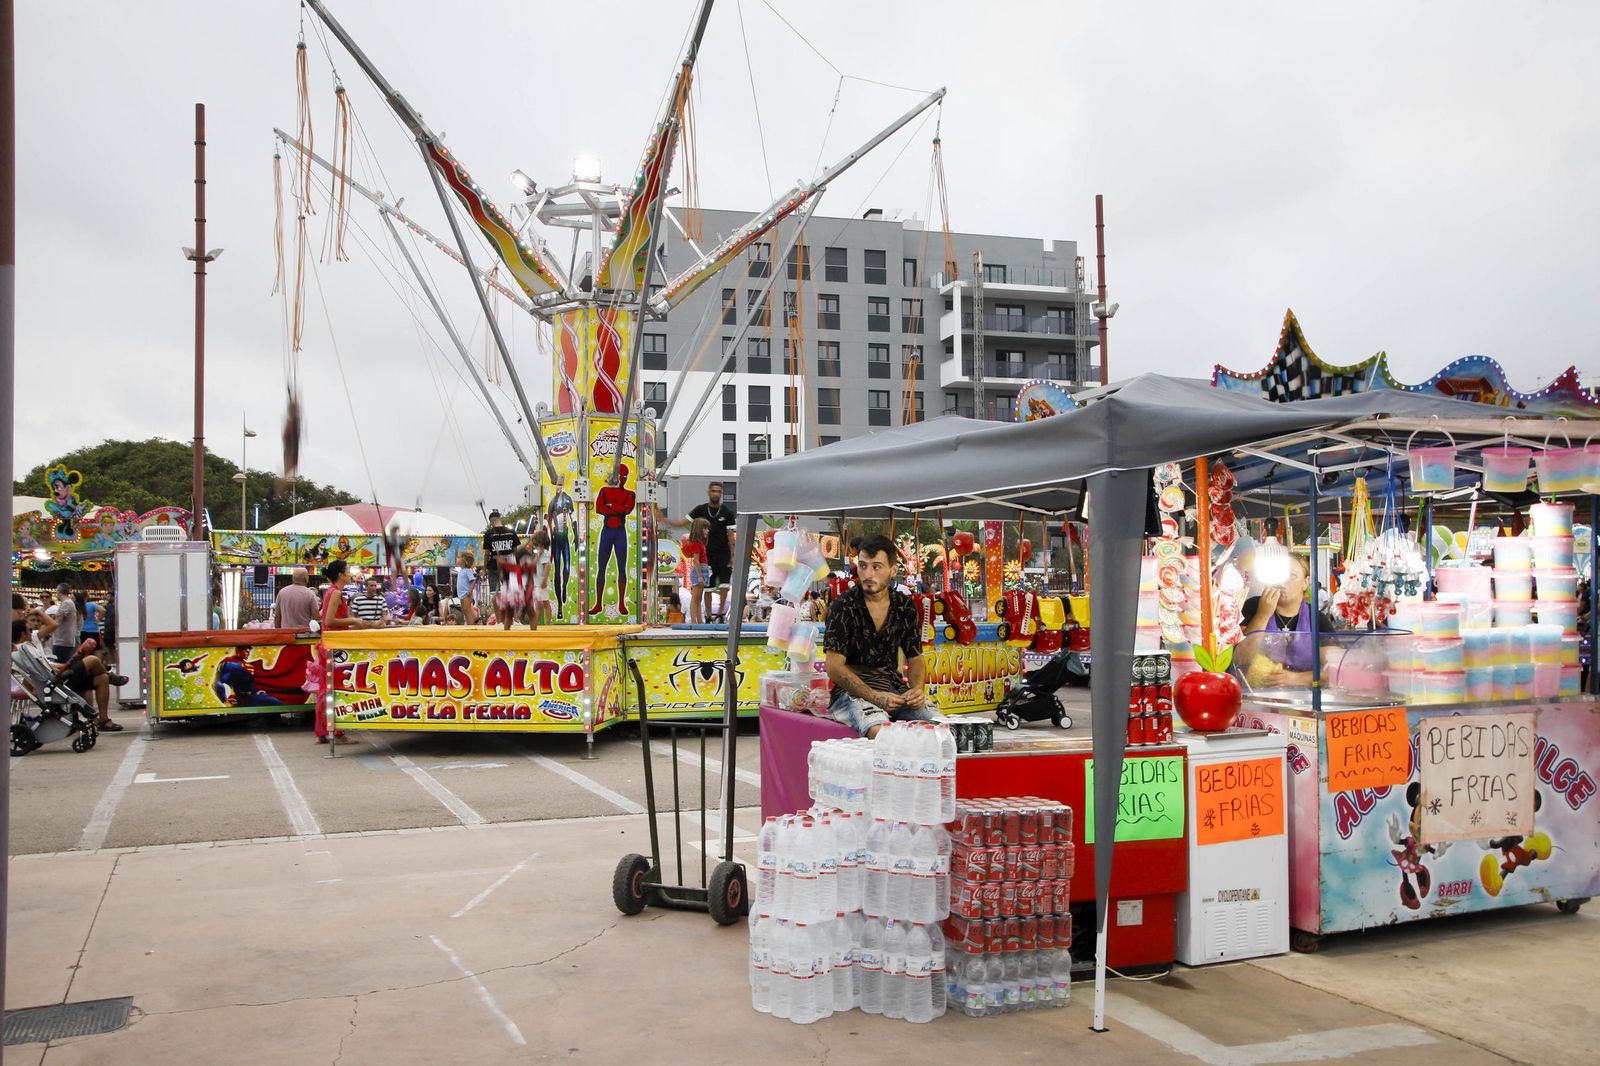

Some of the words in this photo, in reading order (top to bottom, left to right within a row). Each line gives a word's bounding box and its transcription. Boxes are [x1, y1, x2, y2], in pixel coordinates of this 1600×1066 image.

[546, 433, 576, 448] AMERICA
[333, 661, 377, 694] EL
[388, 655, 471, 699] MAS
[485, 657, 583, 697] ALTO
[924, 648, 1019, 684] RACHINAS
[335, 703, 360, 717] IRON
[360, 697, 382, 711] MAN
[391, 703, 420, 719] DE
[427, 702, 456, 719] LA
[463, 702, 531, 720] FERIA
[538, 700, 579, 716] AMERICA
[1289, 731, 1316, 744] MAQUINAS
[1331, 712, 1397, 738] BEBIDAS
[1427, 722, 1529, 764] BEBIDAS
[1119, 760, 1178, 786] BIDAS
[1450, 773, 1518, 807] FRIAS
[1117, 792, 1166, 817] RIAS
[1438, 881, 1473, 897] BARBI
